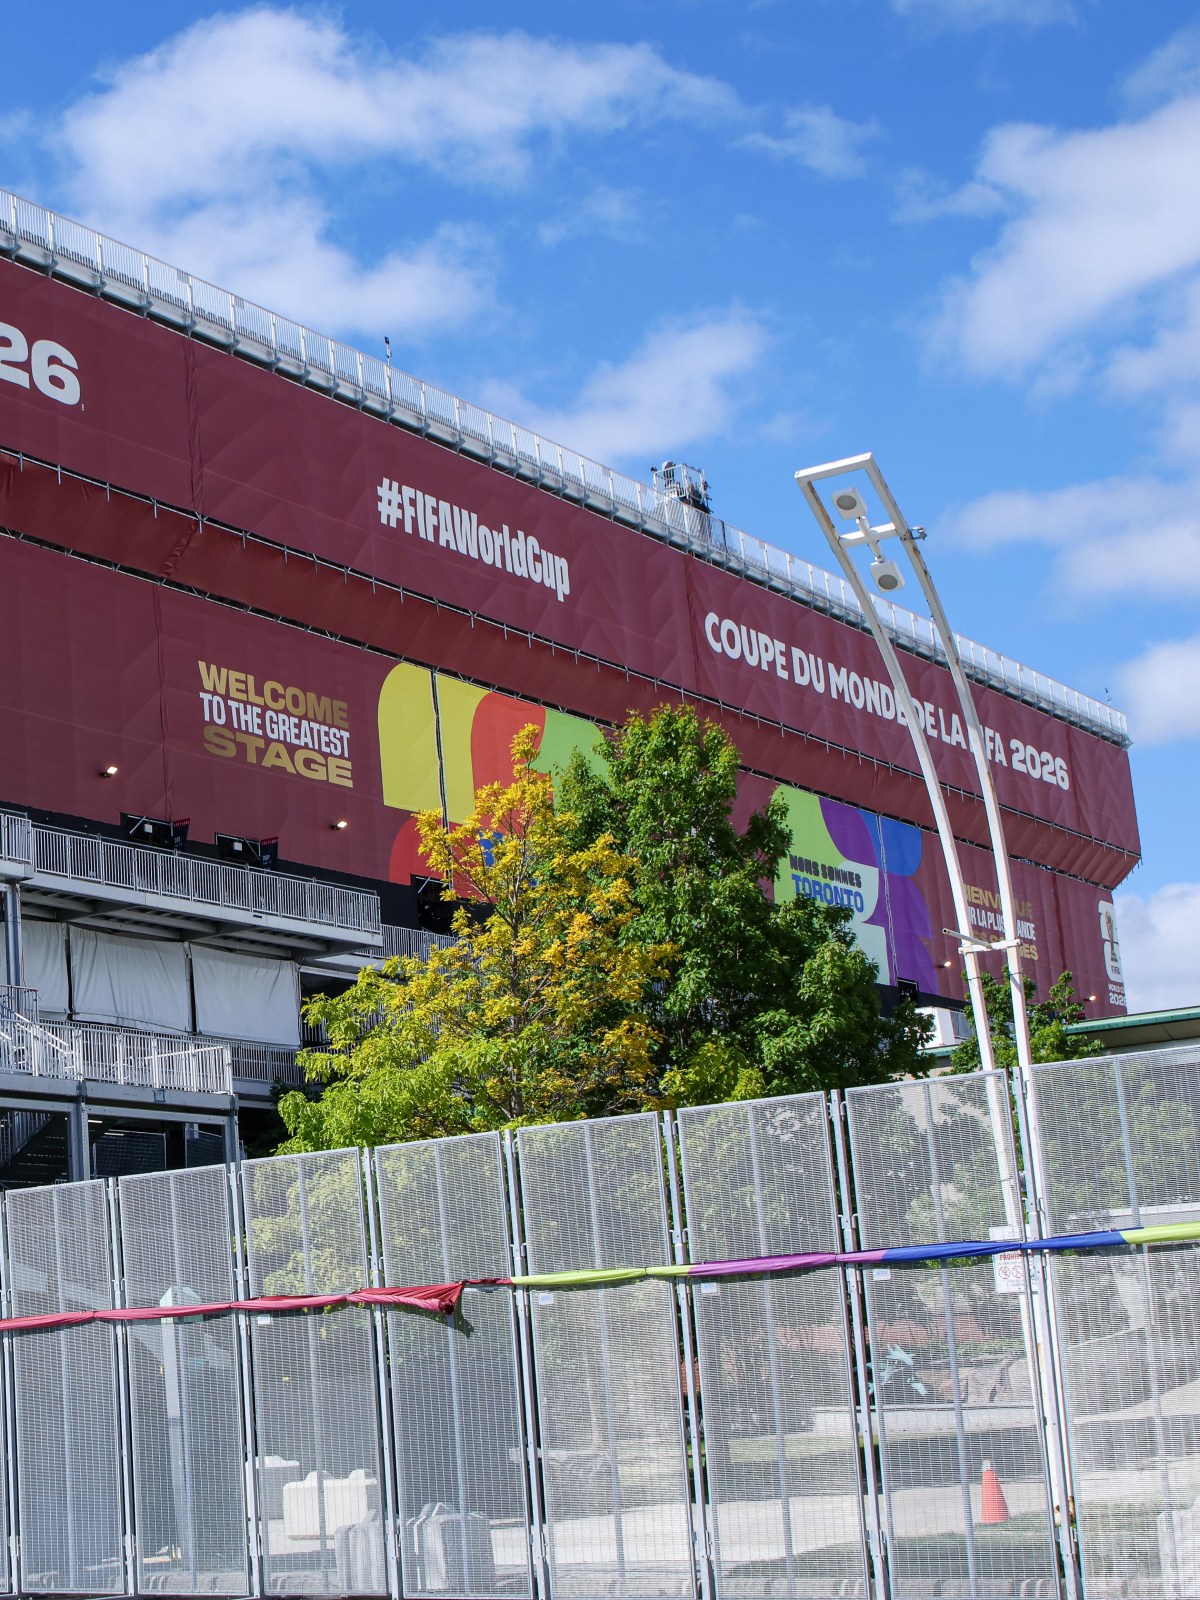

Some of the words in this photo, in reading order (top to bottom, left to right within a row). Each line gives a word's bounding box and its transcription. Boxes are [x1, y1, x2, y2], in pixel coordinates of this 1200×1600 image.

[376, 476, 571, 603] #FIFAWorldCup
[197, 660, 350, 729] WELCOME
[199, 691, 227, 725] TO
[227, 699, 263, 736] THE
[265, 710, 350, 758] GREATEST
[704, 611, 789, 681] COUPE
[791, 646, 825, 694] DU
[938, 707, 967, 750] LA
[1009, 738, 1070, 791] 2026
[202, 724, 354, 789] STAGE
[788, 853, 820, 877] NOUS
[791, 873, 865, 913] TORONTO
[820, 863, 862, 889] SOMMES
[977, 909, 988, 929] LA
